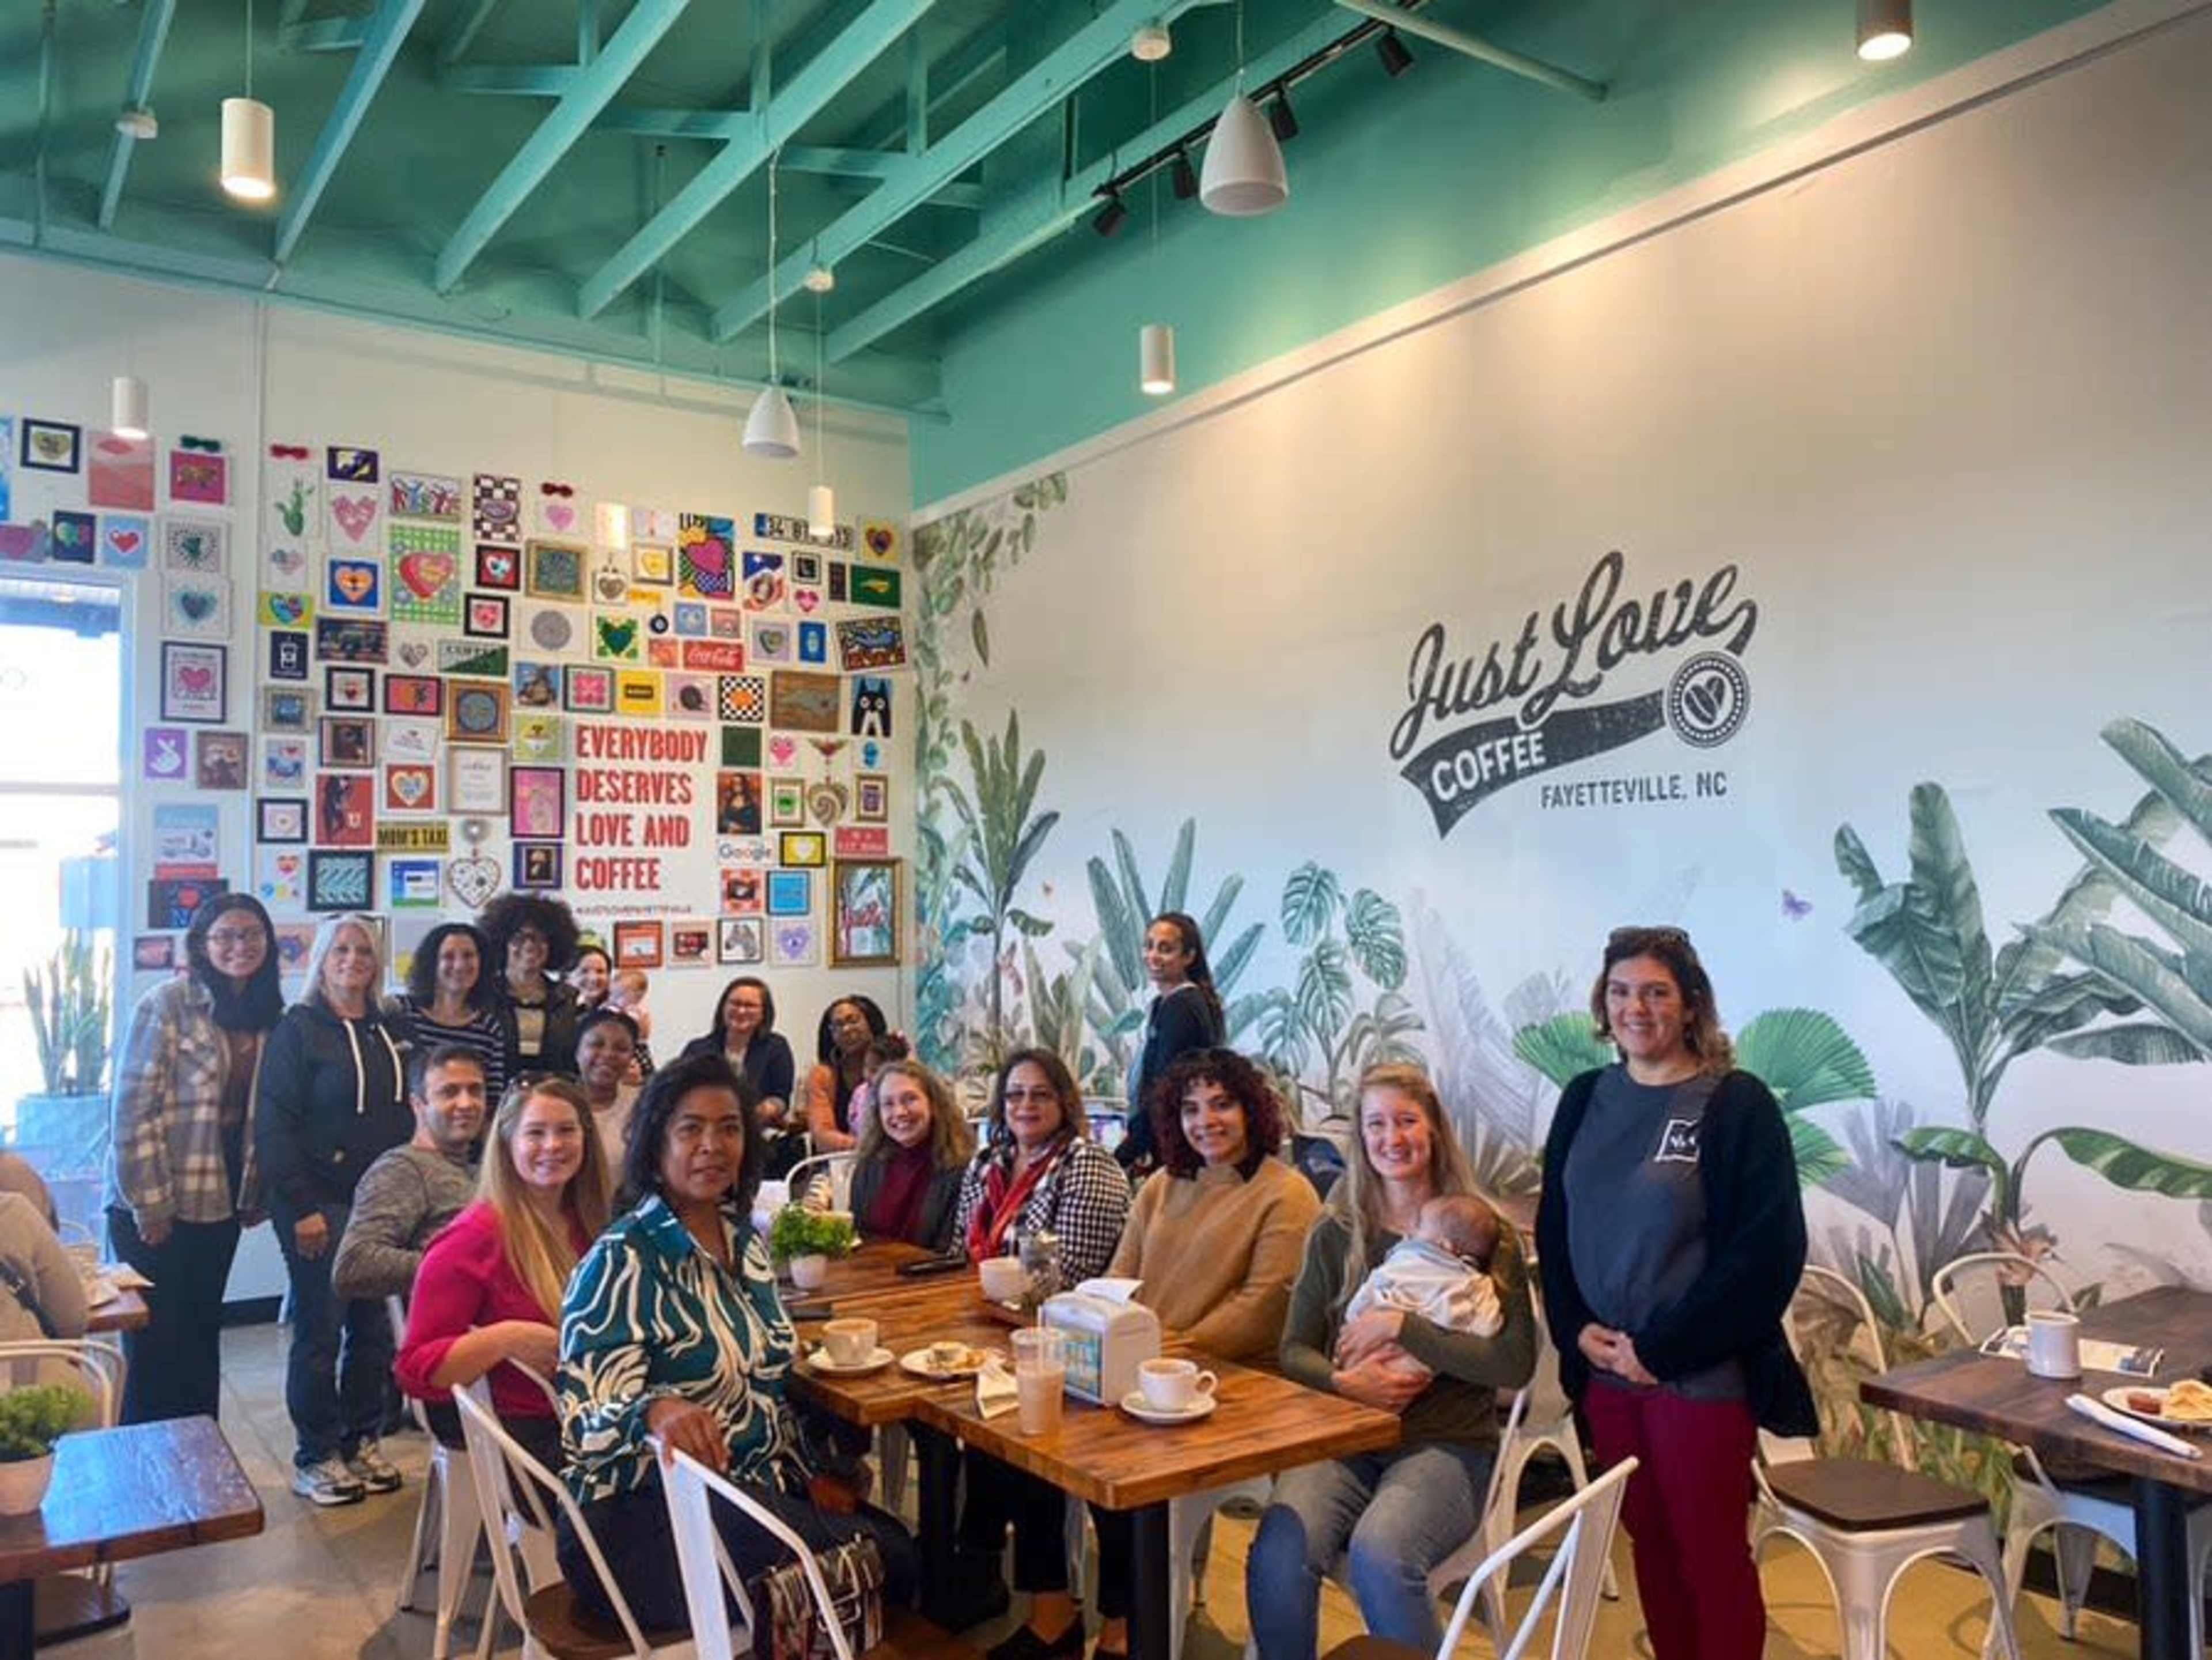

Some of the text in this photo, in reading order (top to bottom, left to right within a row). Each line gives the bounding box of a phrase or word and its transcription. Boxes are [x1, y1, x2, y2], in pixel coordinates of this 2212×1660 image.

[1389, 550, 1758, 760] Just Love
[577, 725, 707, 762] EVERYBODY
[1431, 731, 1547, 802] COFFEE
[1696, 771, 1728, 797] NC
[577, 769, 692, 804] DESERVES
[577, 812, 690, 847] LOVE AND
[576, 857, 661, 890] COFFEE
